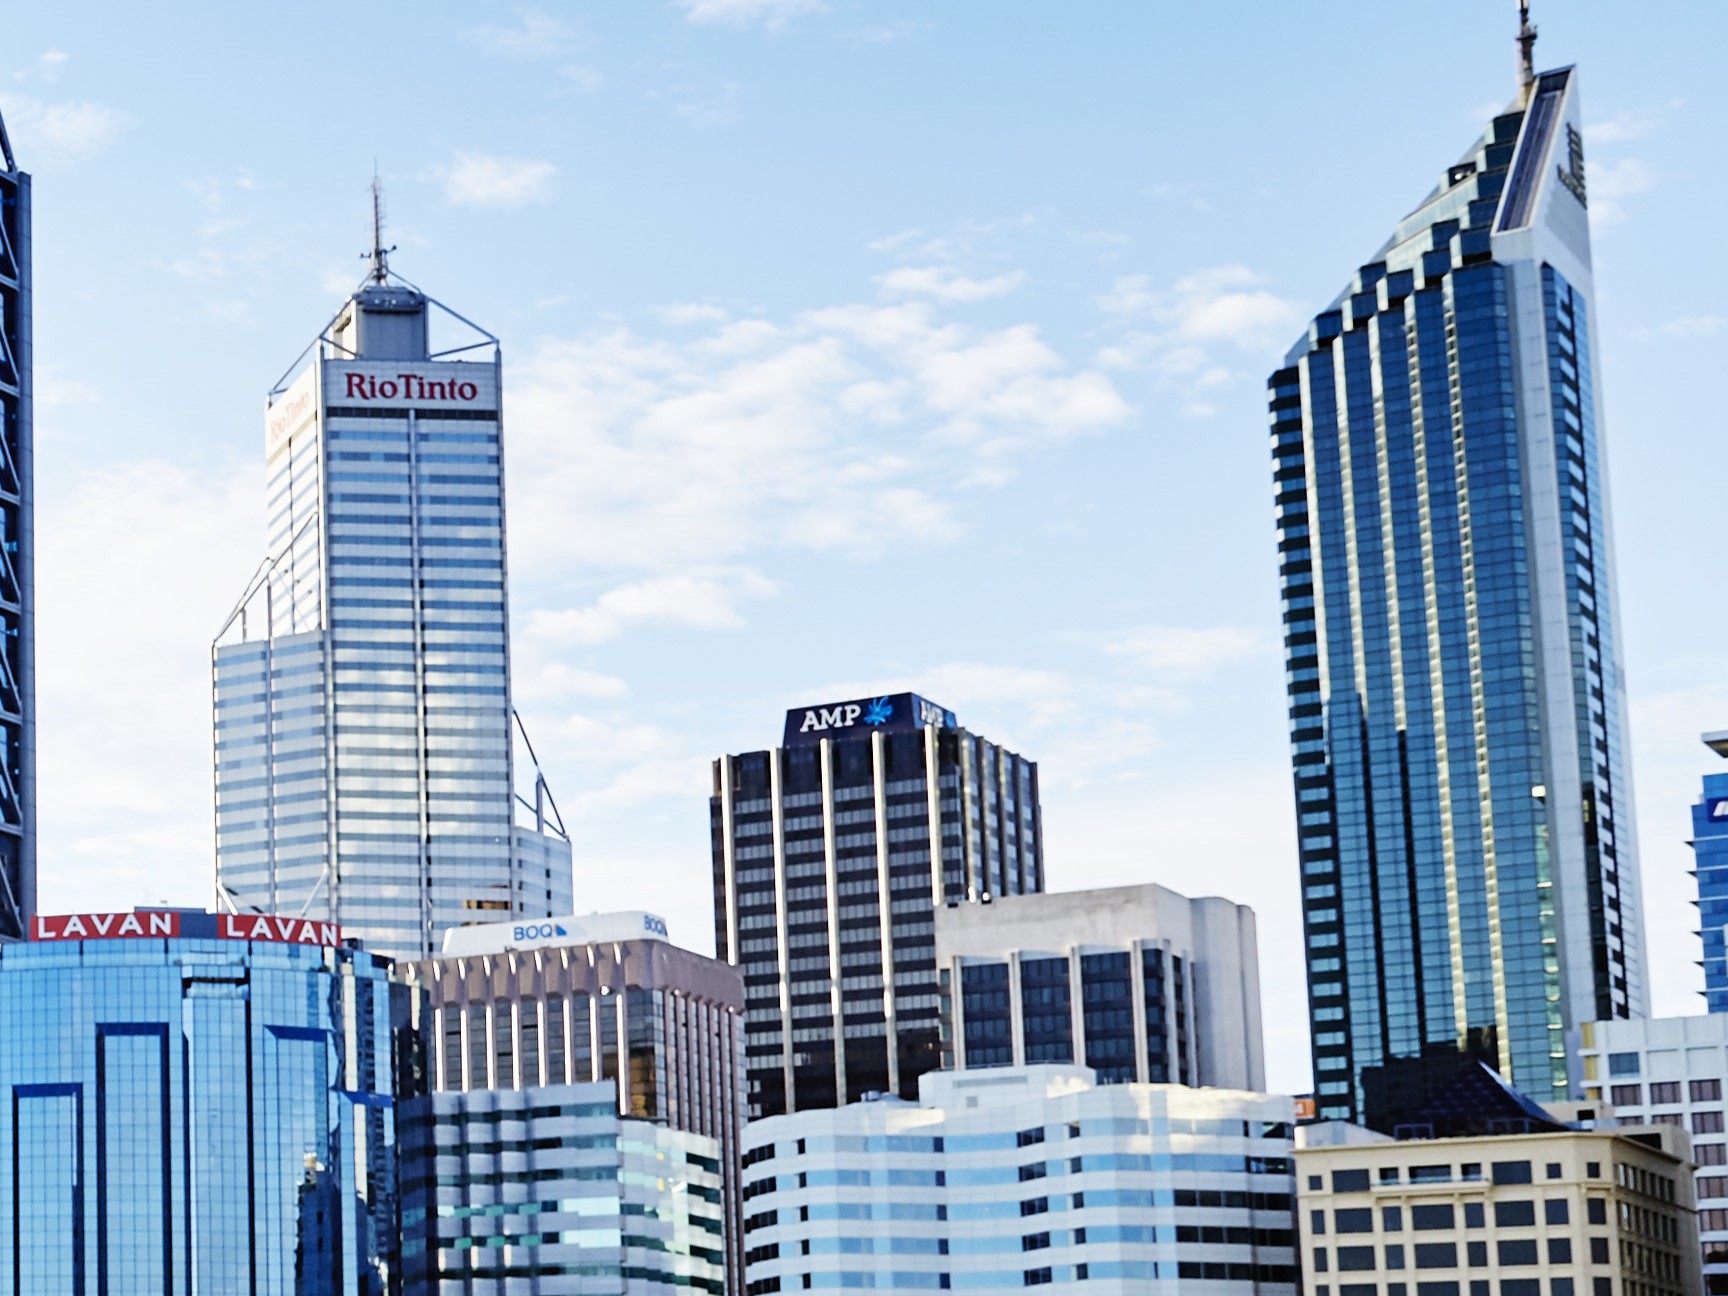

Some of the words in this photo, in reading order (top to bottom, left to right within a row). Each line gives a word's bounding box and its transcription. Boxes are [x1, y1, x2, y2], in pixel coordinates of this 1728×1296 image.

[799, 703, 862, 733] AMP
[37, 912, 172, 939] LAVAN
[226, 914, 337, 947] LAVAN
[513, 923, 553, 941] BOQ
